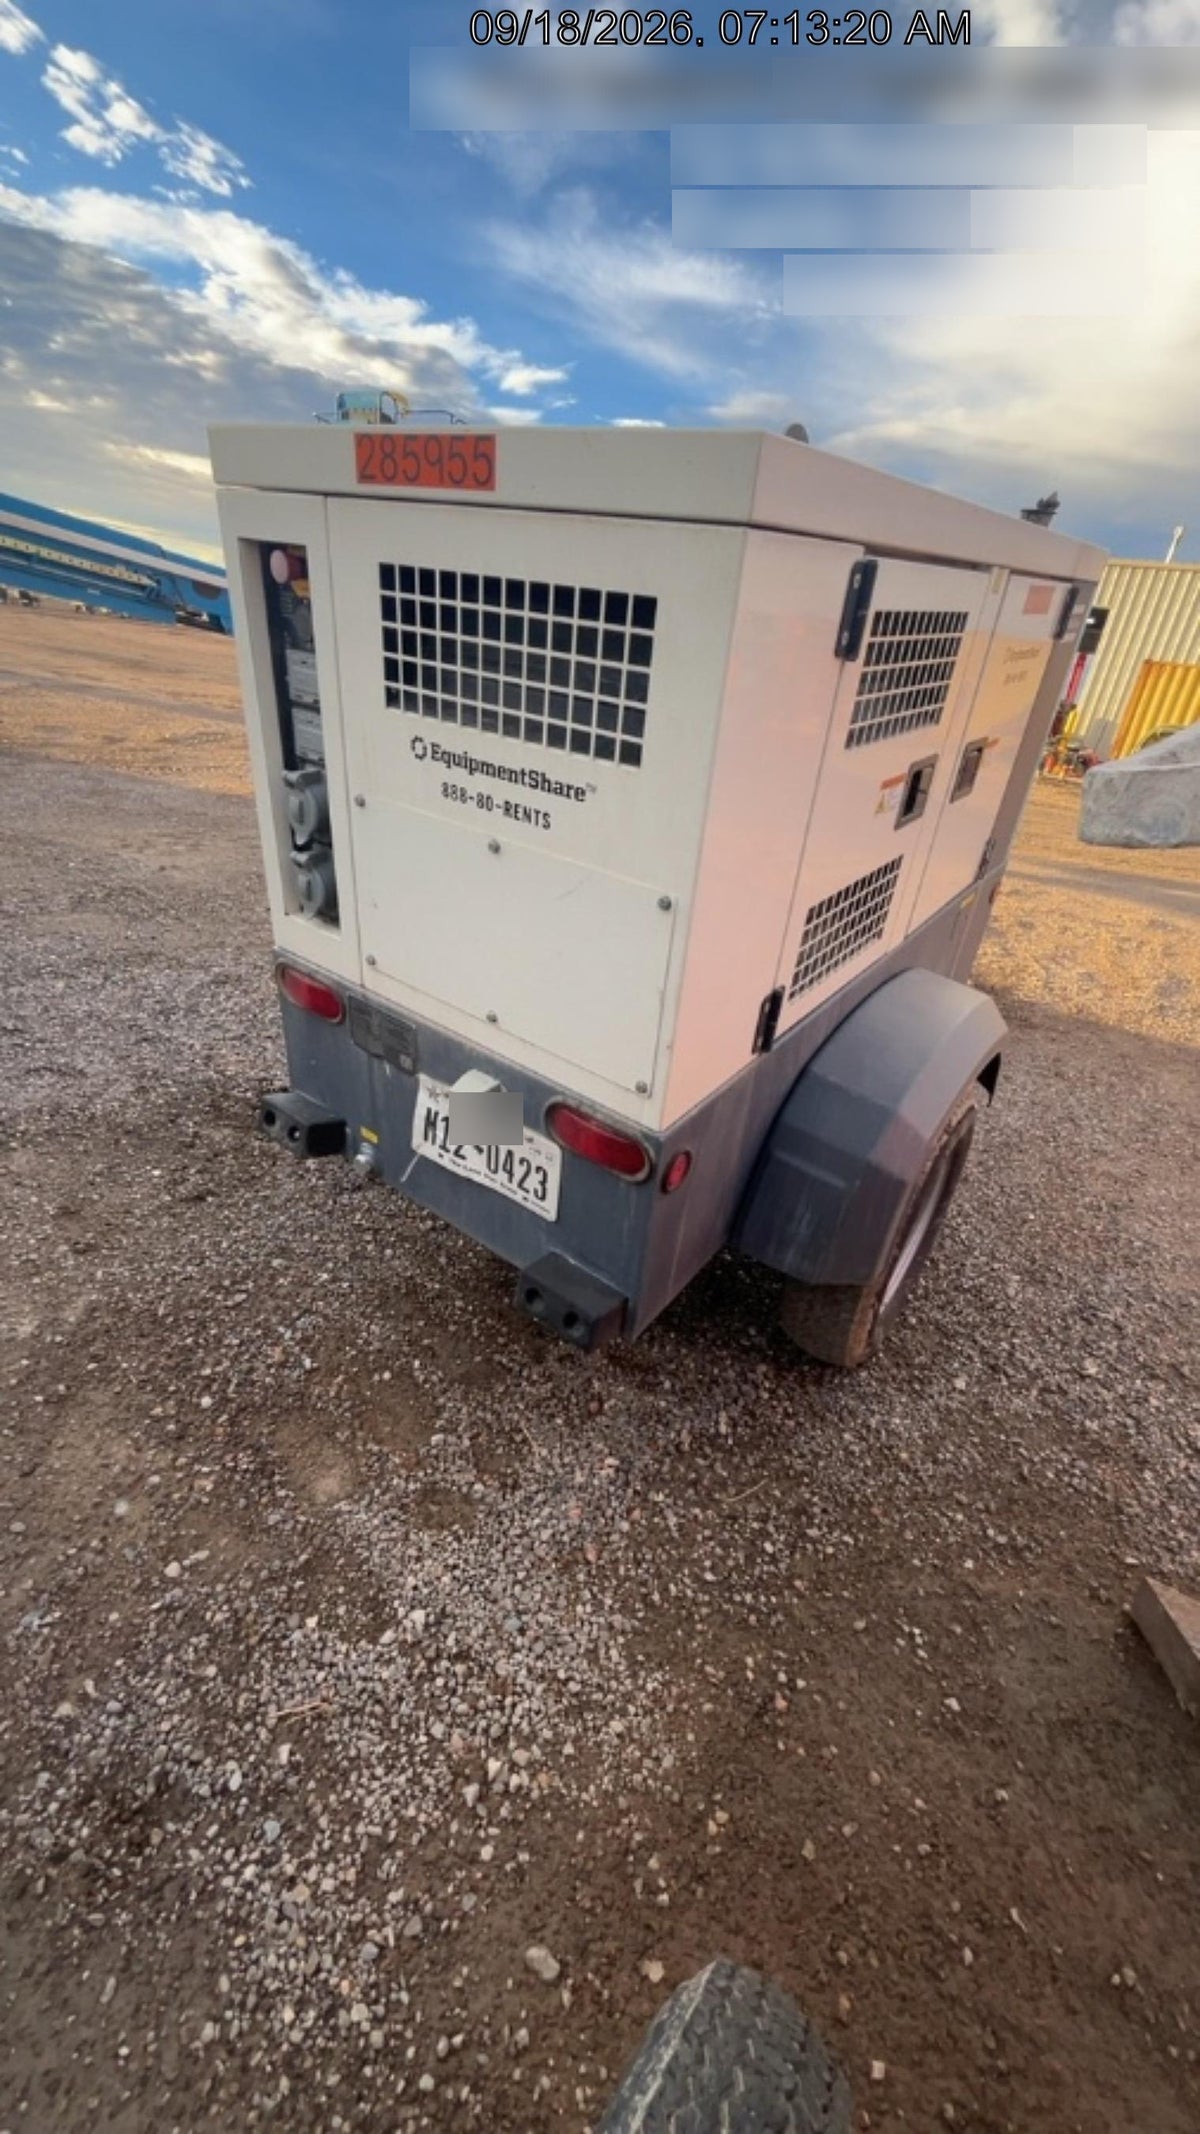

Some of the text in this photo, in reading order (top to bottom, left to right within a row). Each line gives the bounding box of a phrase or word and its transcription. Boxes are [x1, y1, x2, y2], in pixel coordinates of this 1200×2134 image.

[359, 434, 493, 485] 285955
[430, 742, 587, 802] EquipmentShare
[441, 782, 551, 830] 888-80-RENTS
